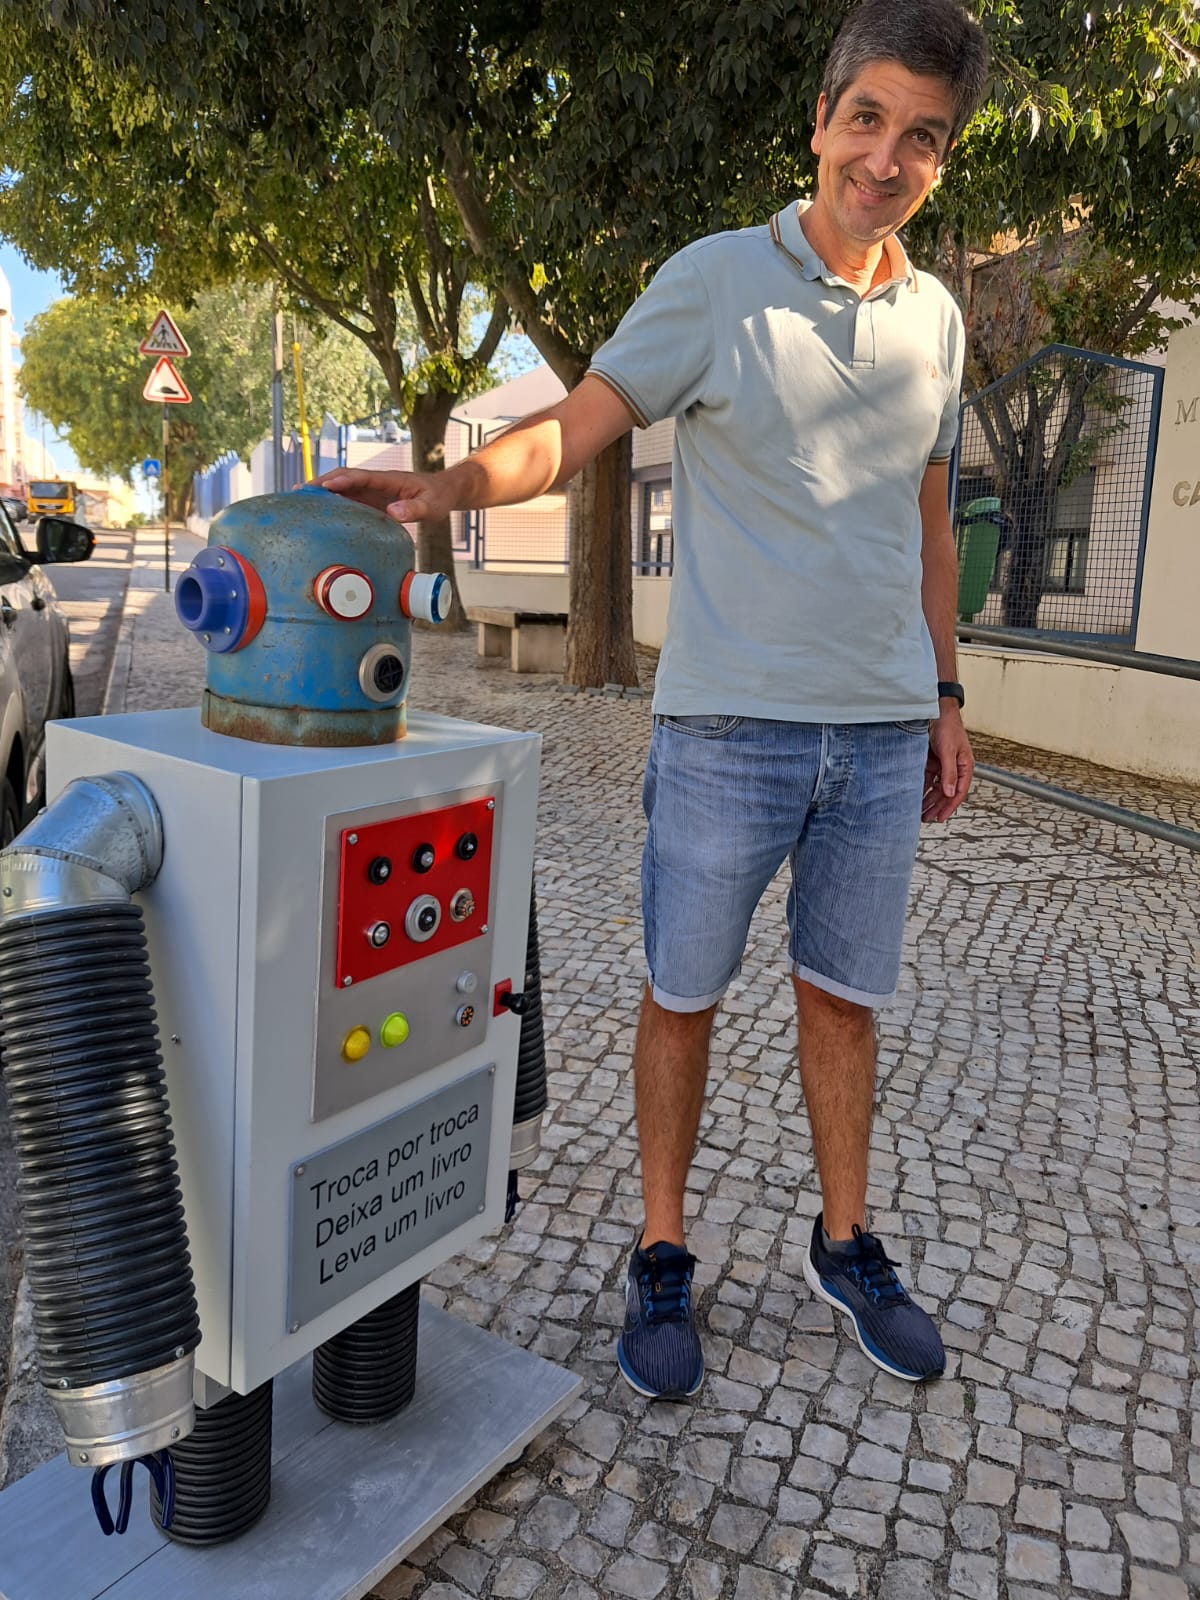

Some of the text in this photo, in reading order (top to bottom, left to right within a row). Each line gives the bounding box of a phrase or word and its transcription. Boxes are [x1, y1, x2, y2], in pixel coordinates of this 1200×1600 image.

[309, 1103, 479, 1210] Troca por troca
[315, 1142, 472, 1249] Deixa um livro
[318, 1180, 465, 1285] Leva um livro
